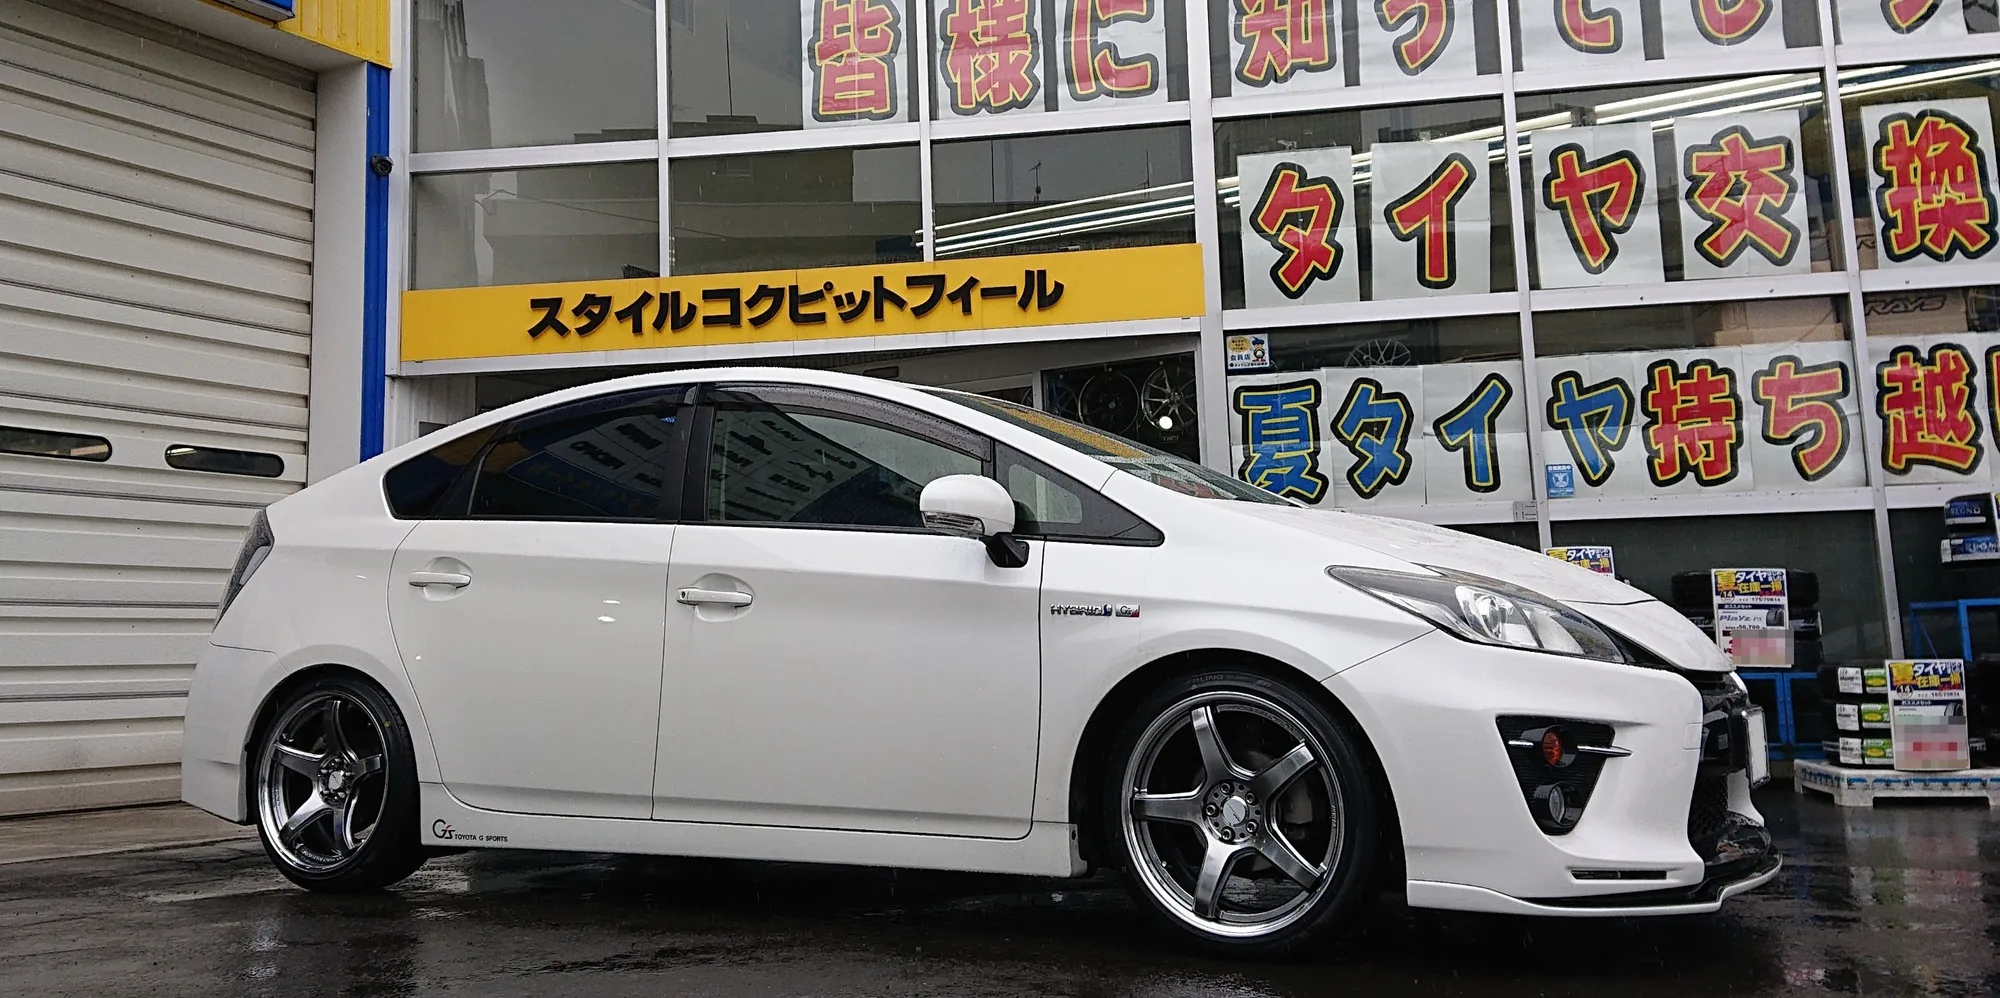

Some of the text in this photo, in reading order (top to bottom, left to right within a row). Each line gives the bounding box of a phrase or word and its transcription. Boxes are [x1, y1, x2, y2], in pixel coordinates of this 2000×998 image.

[1250, 109, 1998, 299] タイヤ交換
[527, 269, 1064, 339] スタイルコクピットフィール
[1233, 343, 2000, 504] 夏タイヤ持ち越
[1050, 605, 1102, 616] HYBRID
